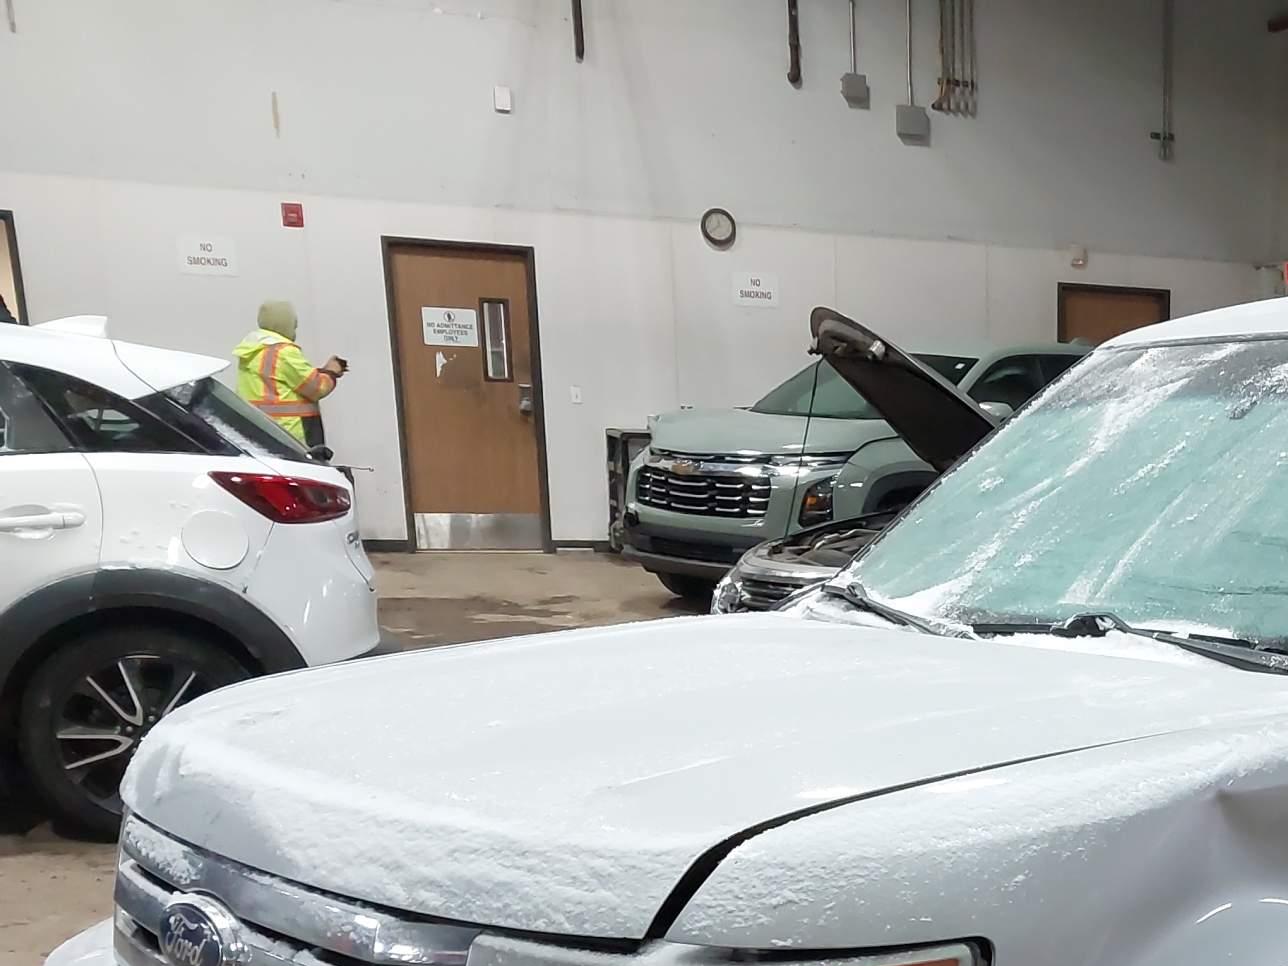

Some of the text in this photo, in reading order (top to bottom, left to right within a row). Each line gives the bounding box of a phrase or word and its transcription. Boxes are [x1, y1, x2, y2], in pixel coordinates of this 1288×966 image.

[199, 243, 213, 252] NO
[187, 256, 228, 267] SMOKING
[750, 278, 761, 287] NO
[739, 289, 772, 300] SMOKING
[436, 322, 473, 330] ADMITTANCE
